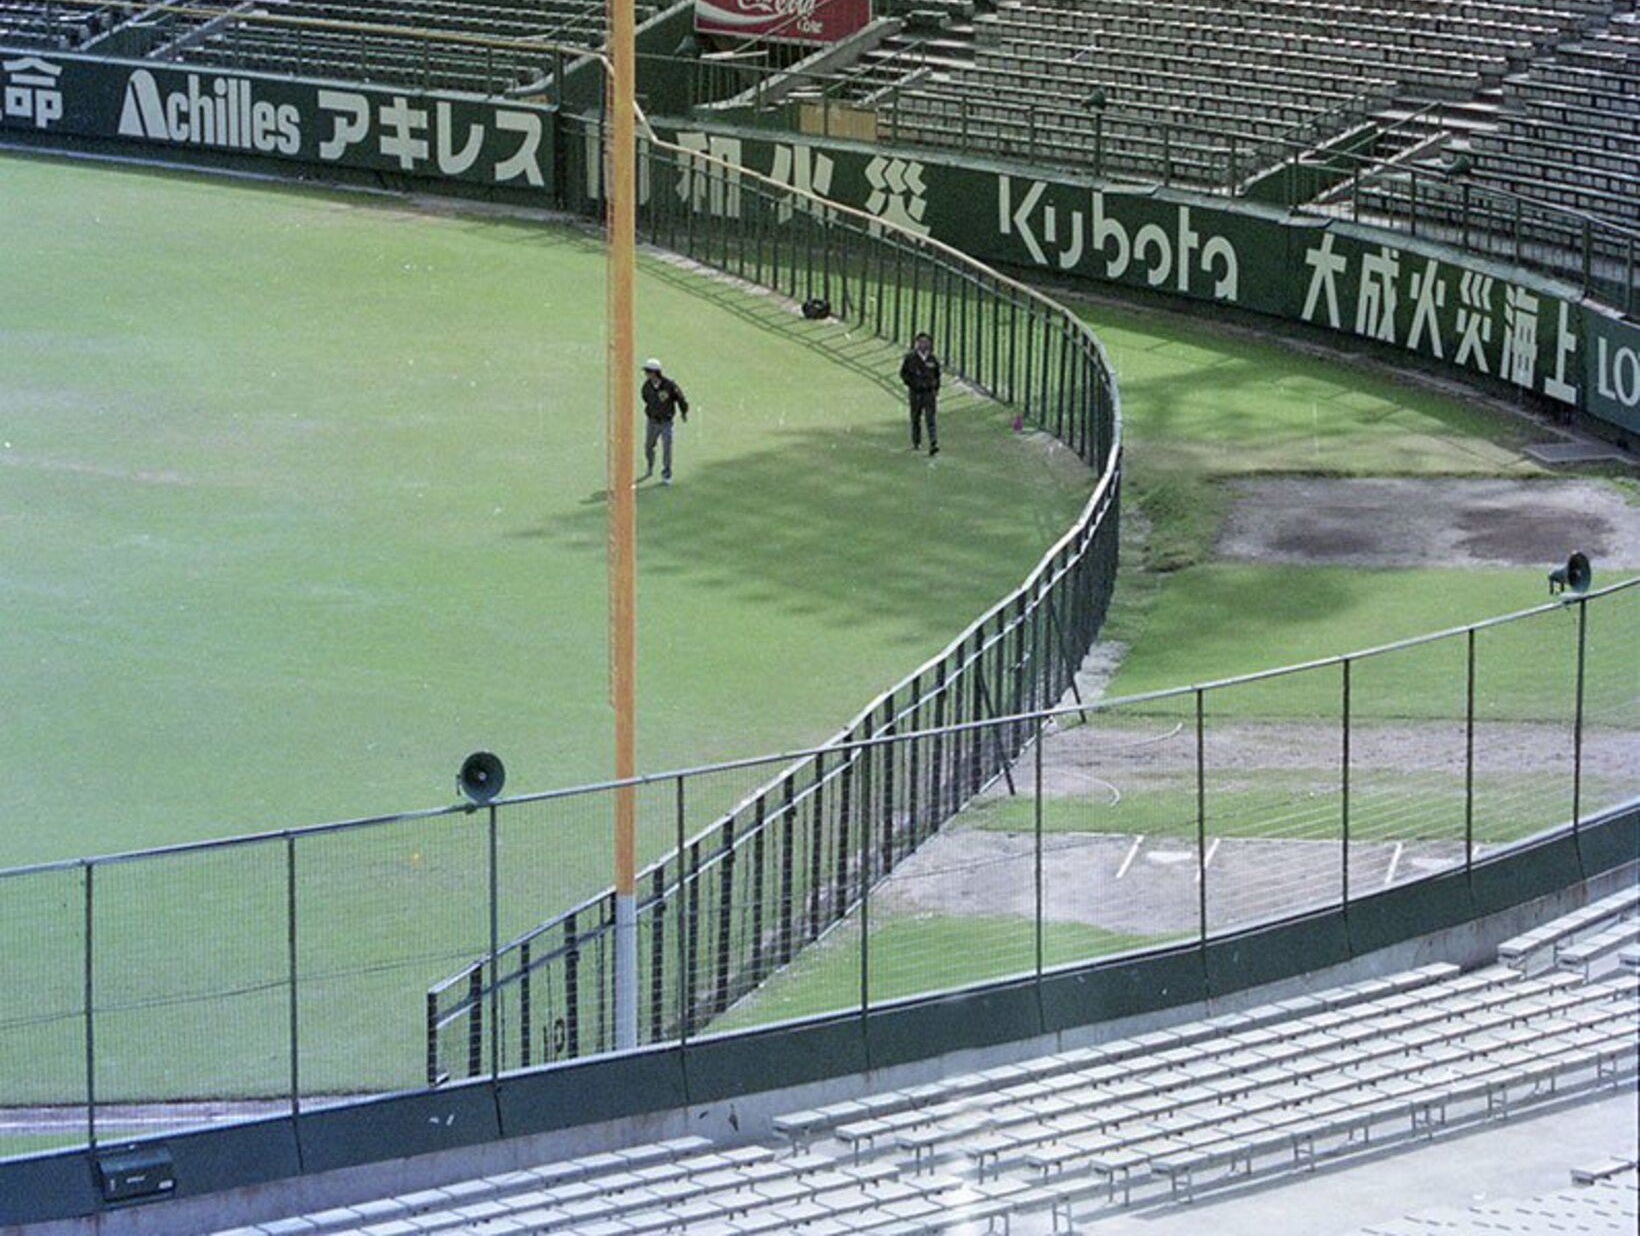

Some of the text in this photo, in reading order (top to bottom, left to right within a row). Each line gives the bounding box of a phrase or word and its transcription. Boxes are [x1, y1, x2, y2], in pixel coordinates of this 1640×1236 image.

[3, 56, 63, 129] 命
[117, 68, 545, 187] Achilles アキレス
[998, 174, 1239, 302] Kubota
[1301, 232, 1578, 405] 大成火災海上
